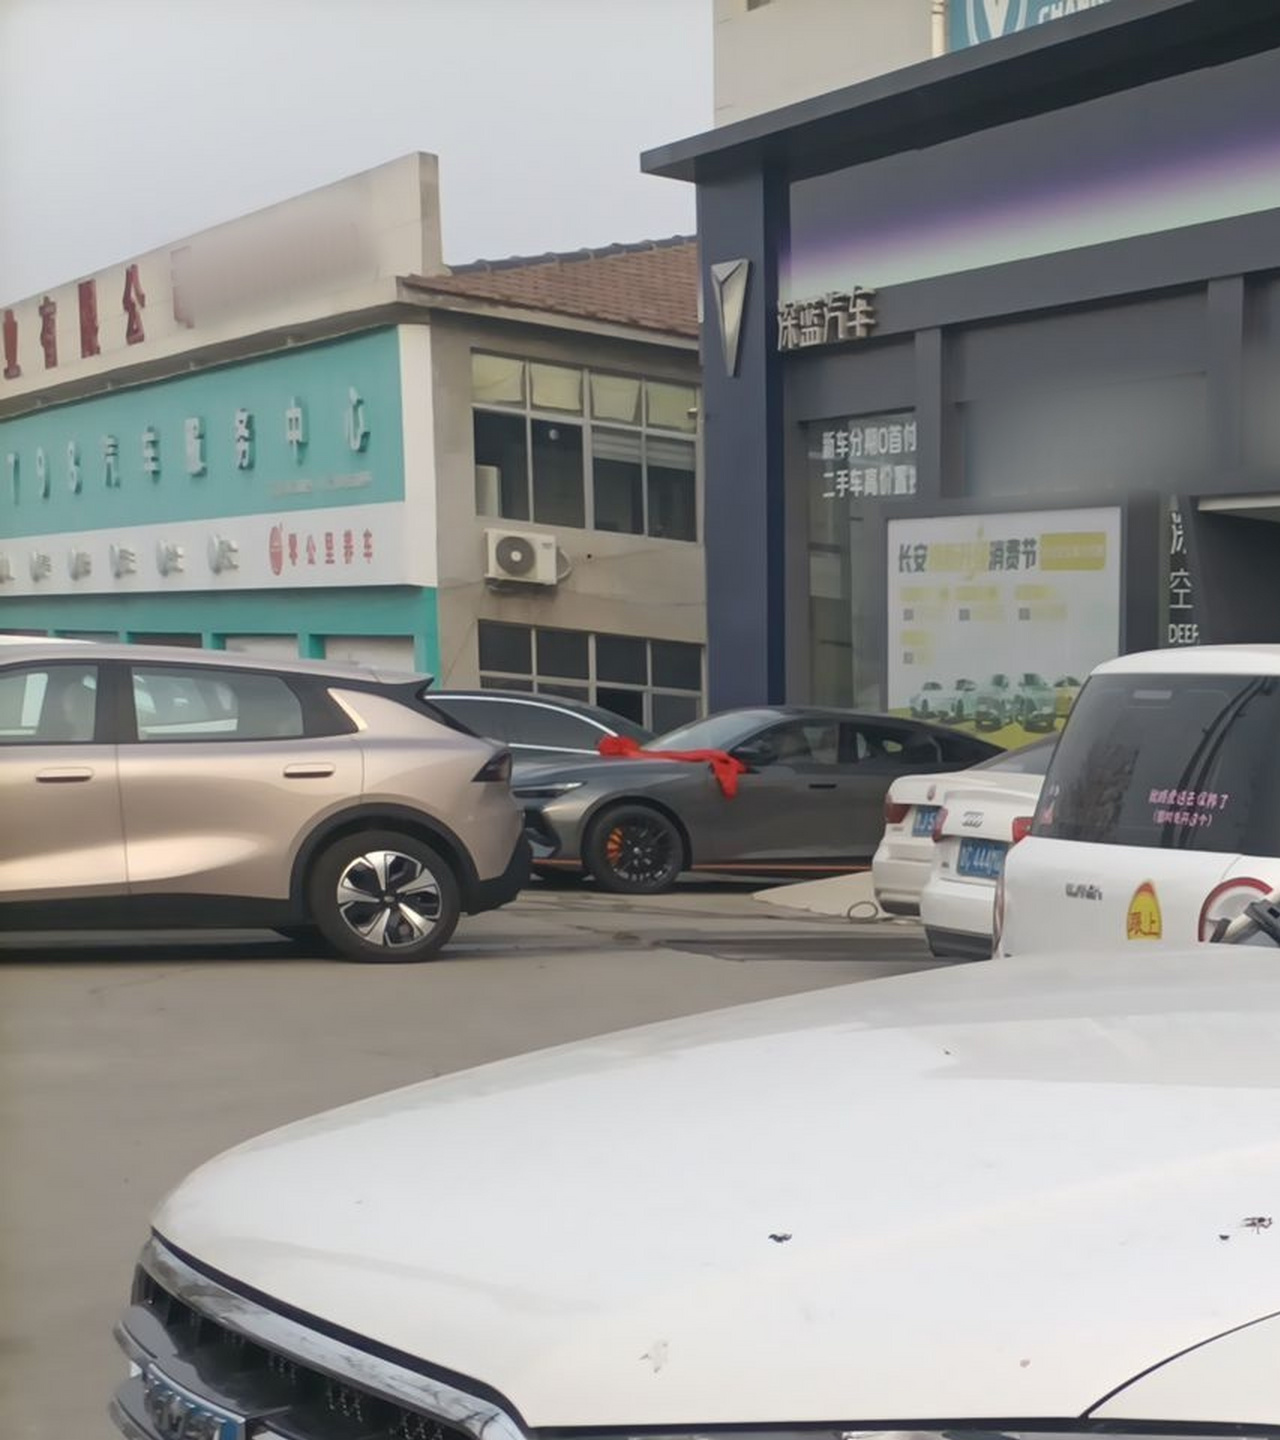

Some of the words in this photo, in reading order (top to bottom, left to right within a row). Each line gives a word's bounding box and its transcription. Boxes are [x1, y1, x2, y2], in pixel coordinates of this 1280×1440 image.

[777, 285, 877, 351] 深蓝汽车
[822, 421, 917, 459] 新车分期0首付
[899, 541, 929, 573] 长安
[988, 538, 1038, 571] 消费节
